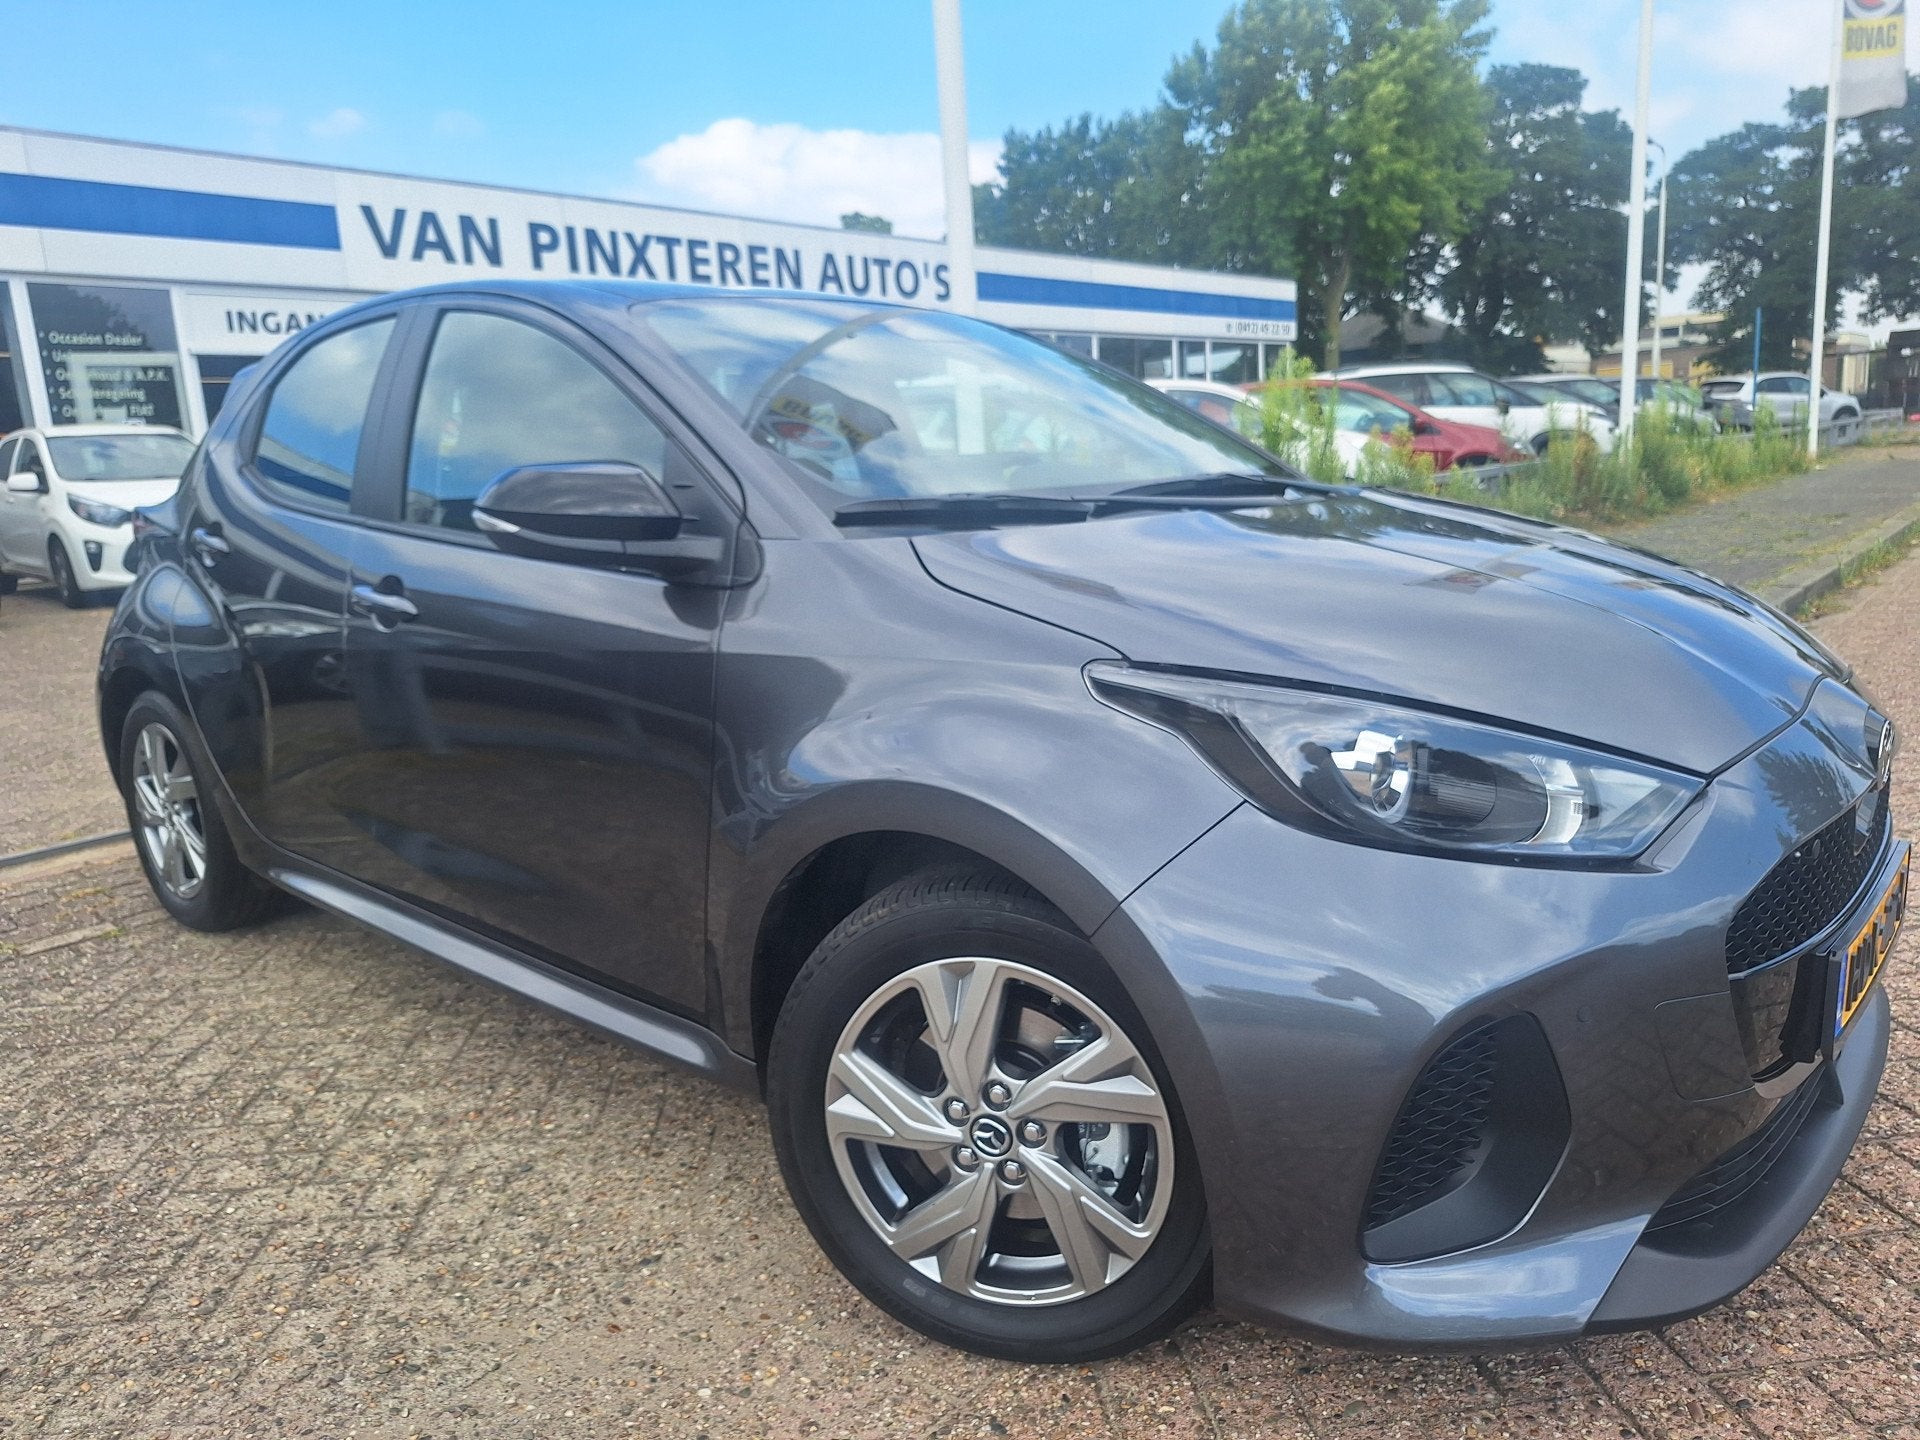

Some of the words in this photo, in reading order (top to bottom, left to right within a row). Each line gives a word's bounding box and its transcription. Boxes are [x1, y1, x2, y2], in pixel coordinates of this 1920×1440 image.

[361, 205, 503, 267] VAN
[527, 222, 805, 290] PINXTEREN
[819, 252, 951, 302] AUTO'S
[48, 331, 103, 345] Occasion
[104, 331, 143, 346] Dealer
